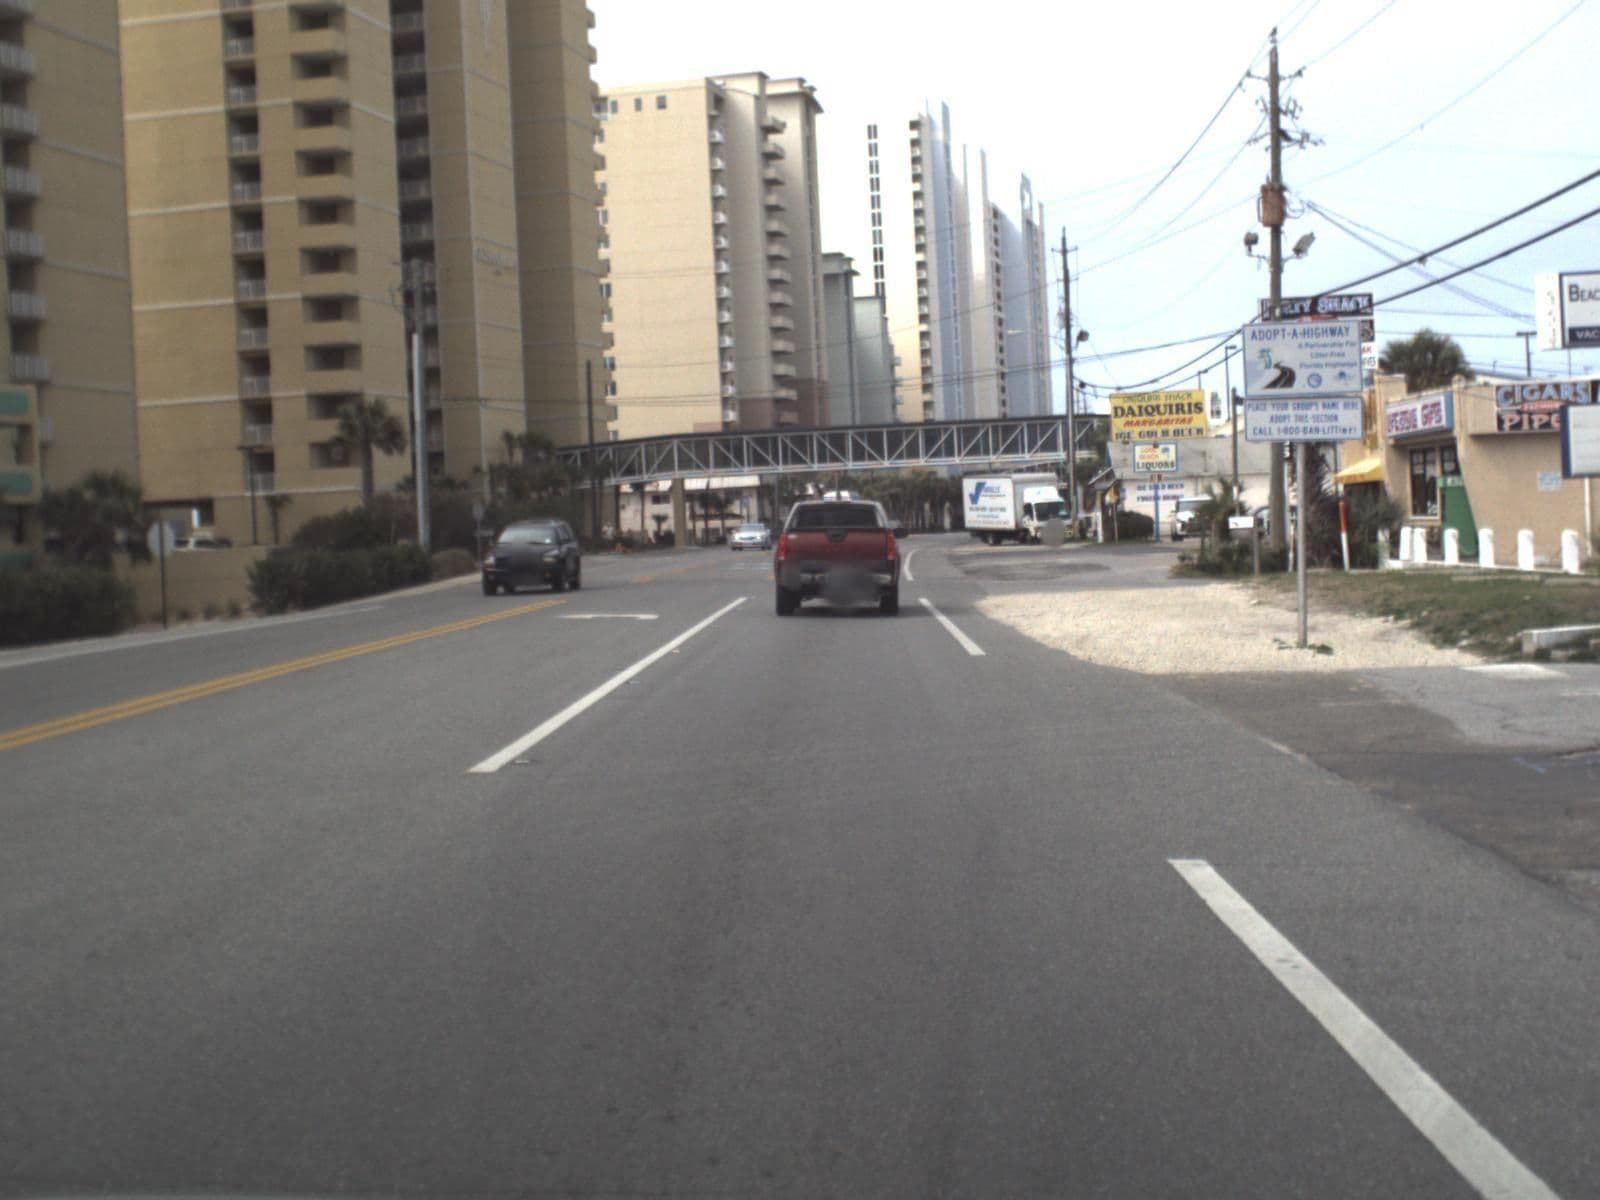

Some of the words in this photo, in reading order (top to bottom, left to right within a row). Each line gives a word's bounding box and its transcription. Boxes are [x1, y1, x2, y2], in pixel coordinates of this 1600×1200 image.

[1251, 326, 1351, 341] ADOPT-A-HIGHWAY
[1497, 383, 1590, 407] CIGARS
[1113, 402, 1204, 418] DAIQUIRIS
[1123, 416, 1194, 427] MARGARITAS
[1253, 427, 1272, 436] CALL
[1137, 461, 1175, 470] LIQUORS
